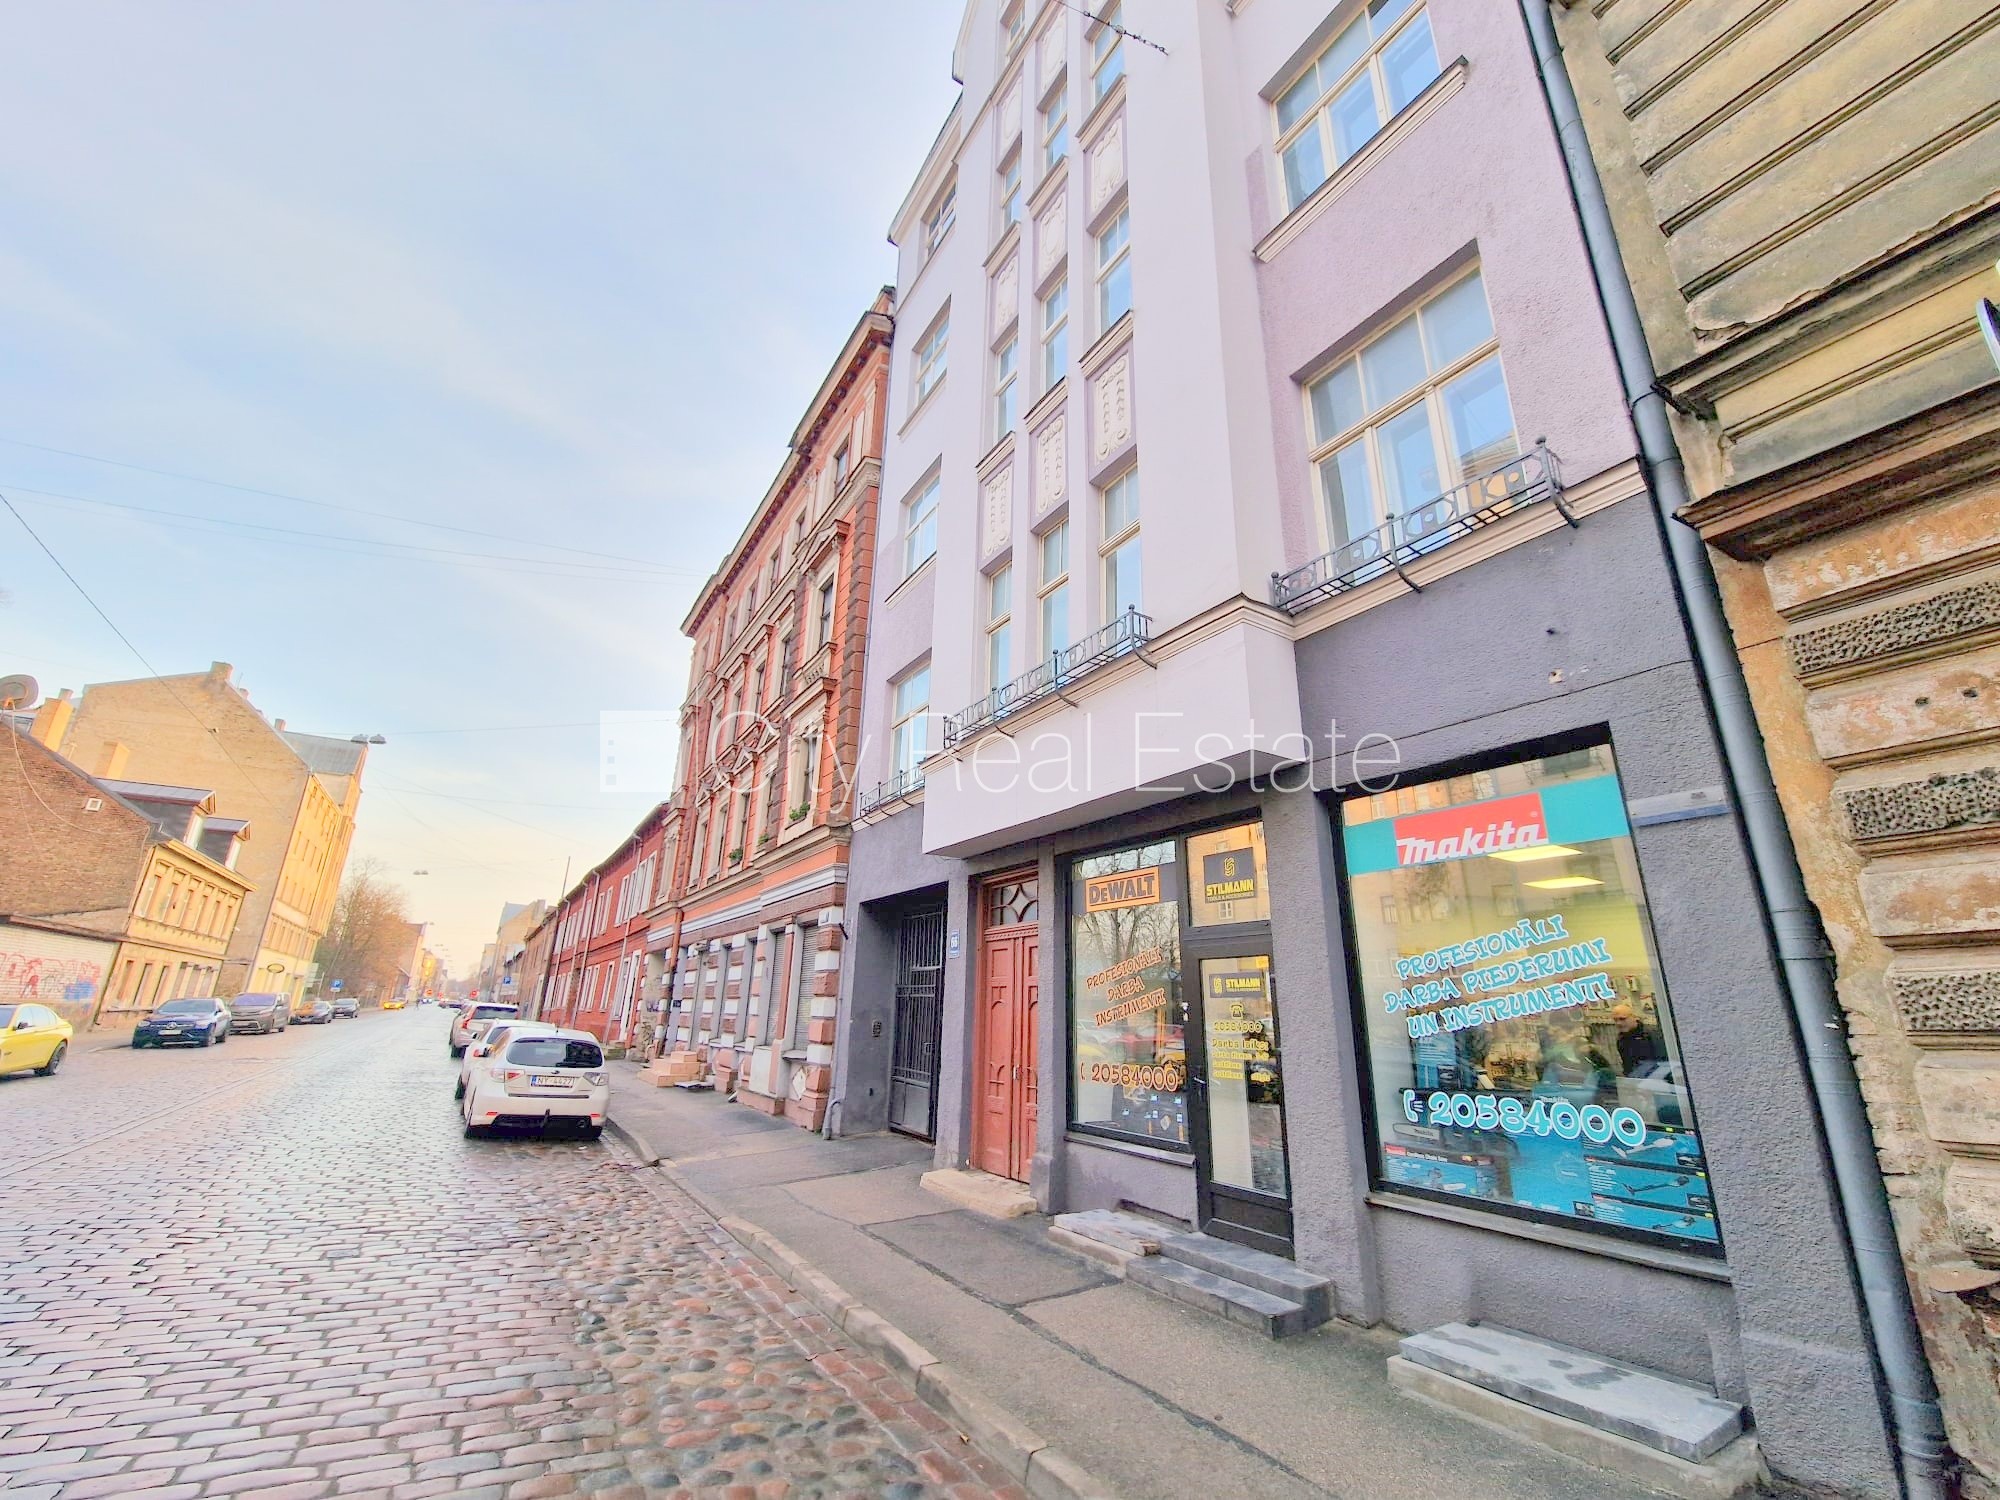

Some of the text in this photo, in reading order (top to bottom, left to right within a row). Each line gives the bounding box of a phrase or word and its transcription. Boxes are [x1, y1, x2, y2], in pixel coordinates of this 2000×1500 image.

[1206, 879, 1254, 897] STILMANN
[1395, 913, 1569, 980] PROFESIONĀLI
[1107, 975, 1146, 1003] DARBA
[1383, 938, 1612, 1014] DARBA PIEDERUMI
[1095, 987, 1167, 1027] INSTRUMENTI
[1406, 972, 1616, 1039] UN INSTRUMENTI
[1090, 1062, 1179, 1093] 20584000
[1427, 1090, 1648, 1147] 20584000
